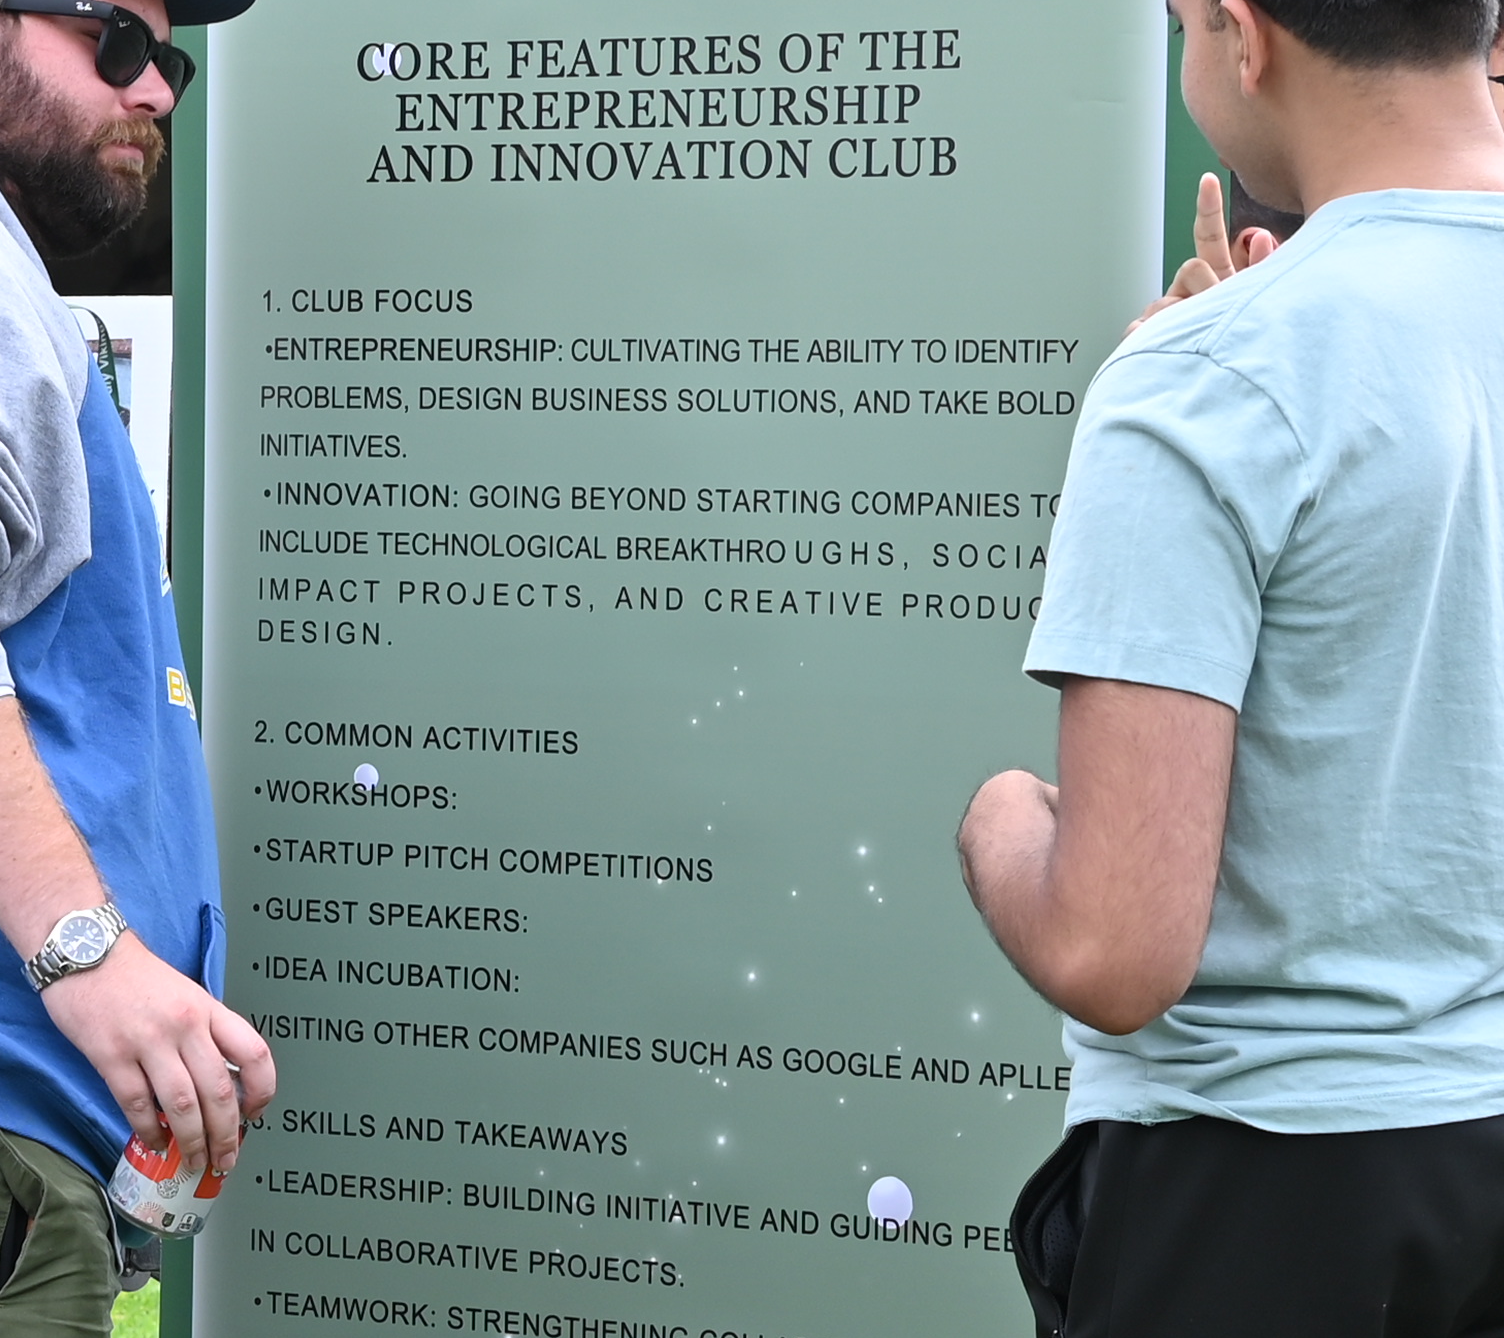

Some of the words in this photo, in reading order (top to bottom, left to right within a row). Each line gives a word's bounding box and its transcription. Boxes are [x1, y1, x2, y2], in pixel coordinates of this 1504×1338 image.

[356, 41, 490, 82] CORE
[506, 34, 761, 79] FEATURES
[778, 32, 845, 74] OF
[859, 29, 961, 71] THE
[395, 84, 921, 132] ENTREPRENEURSHIP
[366, 144, 473, 183] AND
[490, 139, 813, 182] INNOVATION
[828, 136, 957, 179] CLUB
[262, 289, 281, 313] 1.
[291, 289, 364, 313] CLUB
[375, 288, 473, 313] FOCUS
[274, 337, 563, 362] ENTREPRENEURSHIP:
[571, 338, 740, 363] CULTIVATING
[747, 339, 800, 363] THE
[806, 339, 904, 363] ABILITY
[910, 339, 947, 364] TO
[955, 339, 1079, 364] IDENTIFY
[261, 385, 409, 414] PROBLEMS,
[419, 386, 522, 411] DESIGN
[532, 387, 668, 412] BUSINESS
[677, 388, 844, 418] SOLUTIONS,
[853, 389, 910, 414] AND
[918, 390, 989, 415] TAKE
[998, 390, 1075, 415] BOLD
[260, 433, 407, 458] INITIATIVES.
[277, 481, 458, 508] INNOVATION:
[469, 484, 561, 510] GOING
[571, 486, 686, 512] BEYOND
[696, 488, 840, 515] STARTING
[851, 490, 1020, 518] COMPANIES
[259, 529, 369, 555] INCLUDE
[378, 531, 607, 560] TECHNOLOGICAL
[932, 543, 1047, 570] SOCIA
[259, 577, 381, 604] IMPACT
[399, 580, 594, 613] PROJECTS,
[614, 586, 683, 611] AND
[704, 588, 882, 617] CREATIVE
[258, 619, 392, 646] DESIGN.
[254, 719, 275, 744] 2.
[285, 721, 412, 749] COMMON
[422, 726, 578, 755] ACTIVITIES
[266, 779, 457, 810] WORKSHOPS:
[266, 837, 394, 867] STARTUP
[405, 844, 488, 871] PITCH
[499, 848, 713, 883] COMPETITIONS
[265, 896, 359, 925] GUEST
[368, 902, 528, 933] SPEAKERS:
[265, 955, 328, 983] IDEA
[338, 959, 519, 993] INCUBATION:
[250, 1013, 364, 1043] VISITING
[373, 1021, 470, 1050] OTHER
[478, 1027, 641, 1061] COMPANIES
[651, 1038, 727, 1067] SUCH
[736, 1044, 773, 1070] AS
[782, 1047, 902, 1080] GOOGLE
[910, 1057, 970, 1084] AND
[978, 1061, 1072, 1092] APLLE
[282, 1108, 376, 1138] SKILLS
[385, 1116, 444, 1142] AND
[454, 1120, 628, 1156] TAKEAWAYS
[268, 1168, 452, 1206] LEADERSHIP:
[463, 1183, 595, 1217] BUILDING
[606, 1194, 750, 1230] INITIATIVE
[759, 1207, 819, 1235] AND
[830, 1213, 953, 1247] GUIDING
[251, 1228, 275, 1253] IN
[285, 1231, 518, 1273] COLLABORATIVE
[529, 1250, 684, 1288] PROJECTS.
[266, 1290, 436, 1328] TEAMWORK:
